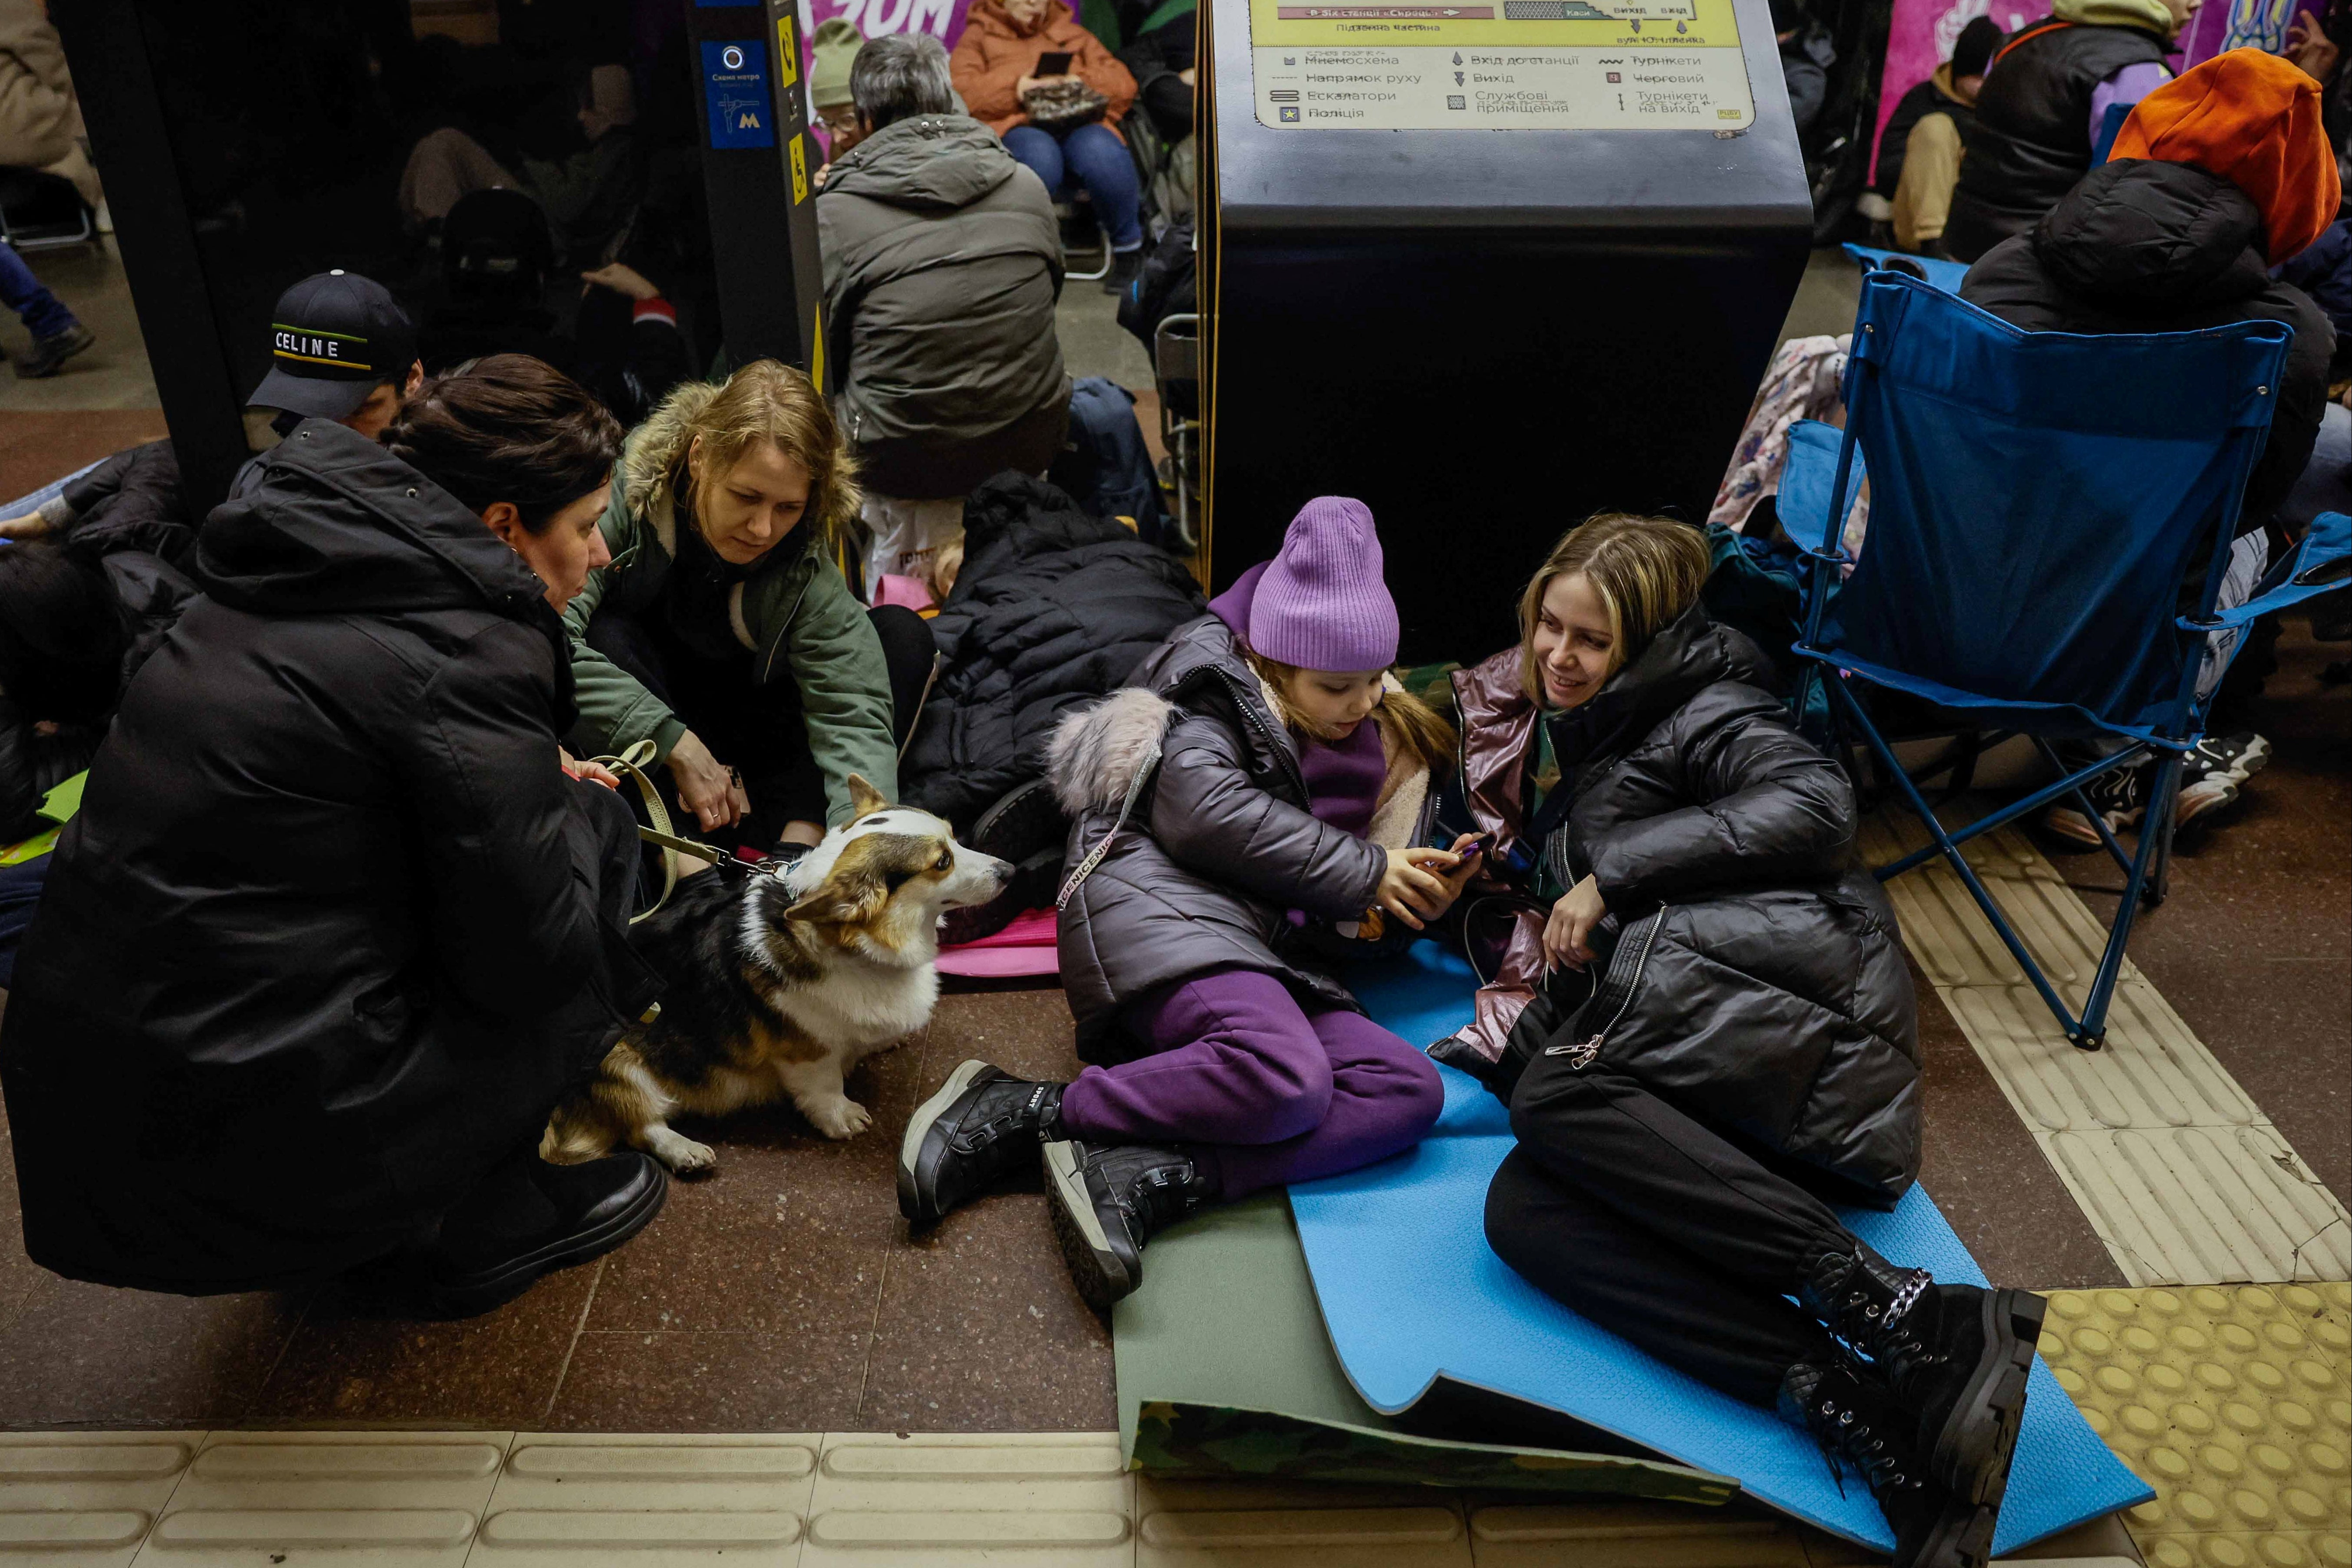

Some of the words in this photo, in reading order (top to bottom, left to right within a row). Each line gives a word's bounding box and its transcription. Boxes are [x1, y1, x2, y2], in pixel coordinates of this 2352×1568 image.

[1336, 24, 1390, 32] Підземна
[1305, 56, 1399, 65] Мнемосхема
[1471, 56, 1503, 65] Вхід
[1507, 56, 1525, 66] до
[1529, 55, 1580, 65] станції
[1631, 56, 1701, 66] Турнікети
[1306, 74, 1382, 83] Напрямок
[1387, 75, 1421, 84] руху
[1473, 74, 1515, 83] Вихід
[1633, 74, 1704, 83] Черговий
[1308, 92, 1396, 101] Ескалатори
[1476, 91, 1548, 101] Службові
[1636, 92, 1708, 102] Турнікети
[1309, 108, 1364, 118] Поліція
[1477, 104, 1569, 114] приміщення
[1661, 105, 1700, 114] вихід
[276, 332, 338, 357] CELINE
[1029, 1087, 1044, 1108] SPORT
